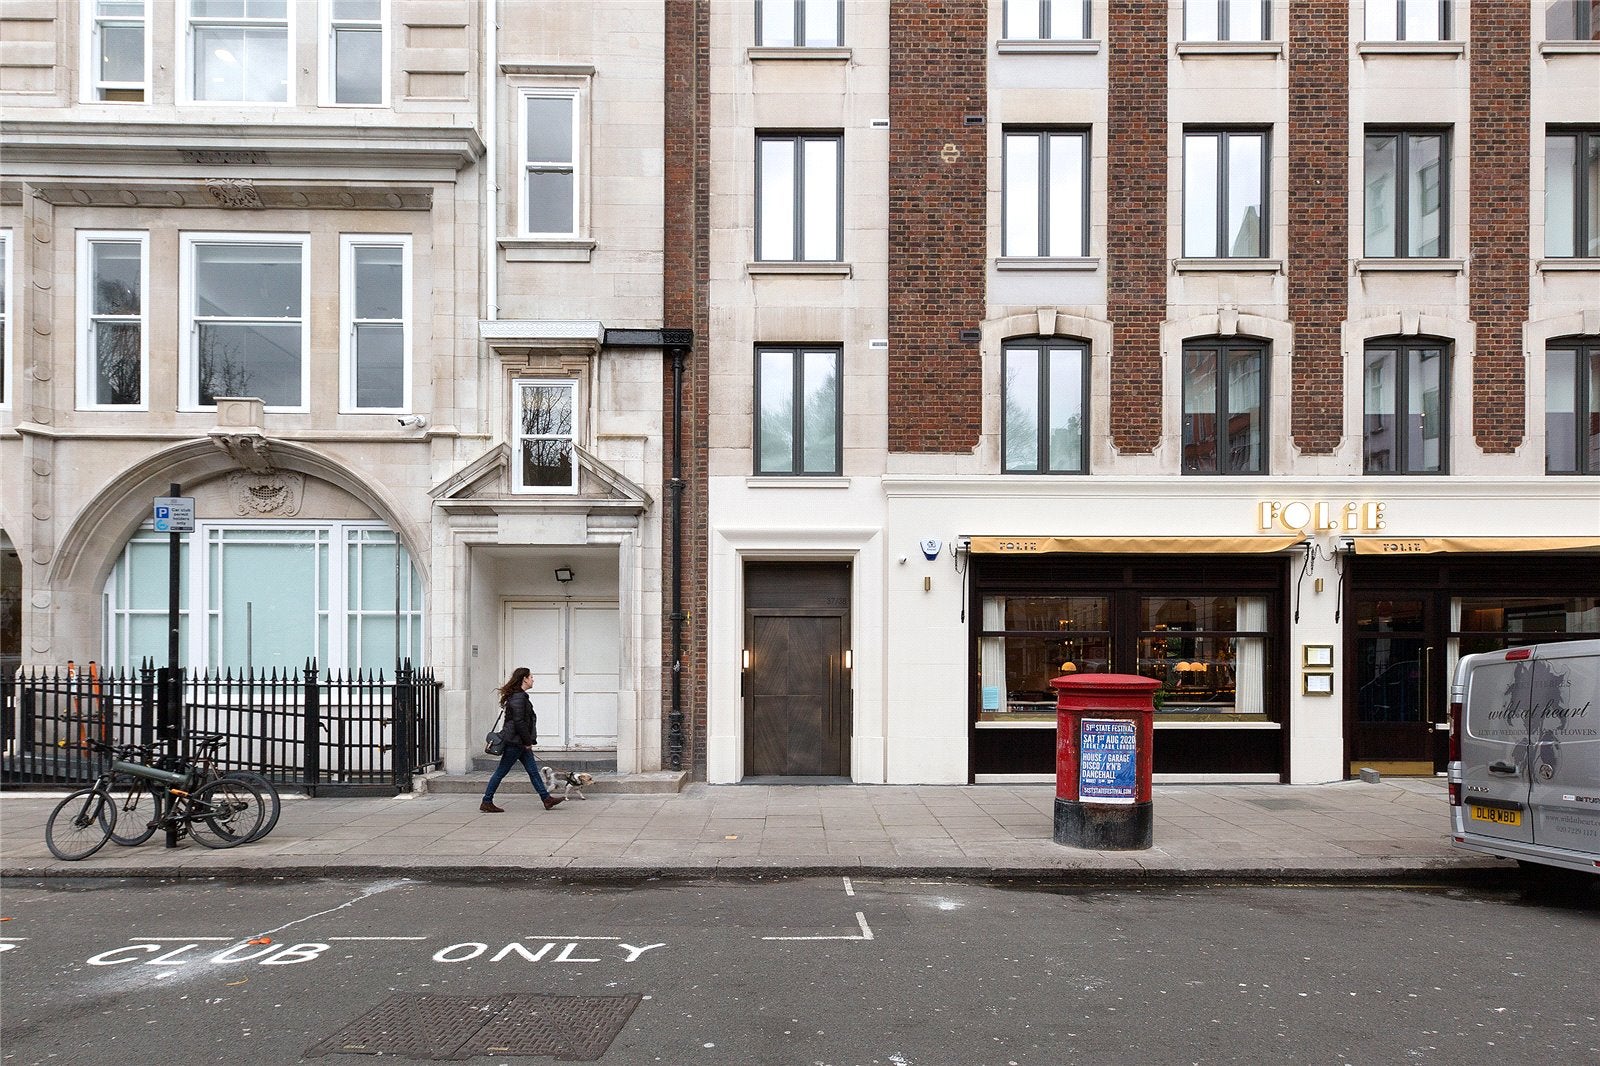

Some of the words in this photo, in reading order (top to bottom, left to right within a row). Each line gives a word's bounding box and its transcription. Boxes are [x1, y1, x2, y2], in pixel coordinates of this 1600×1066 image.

[1541, 698, 1591, 719] heart
[1095, 724, 1111, 732] STATE
[1083, 734, 1096, 743] SAT
[1106, 736, 1119, 744] AUG
[1120, 736, 1136, 744] 2020
[1082, 753, 1102, 761] HOUSE
[1107, 754, 1130, 762] GARAGE
[1082, 762, 1101, 770] DISCO
[1082, 770, 1116, 779] DANCEHALL
[86, 943, 330, 966] CLUB
[432, 942, 667, 963] ONLY
